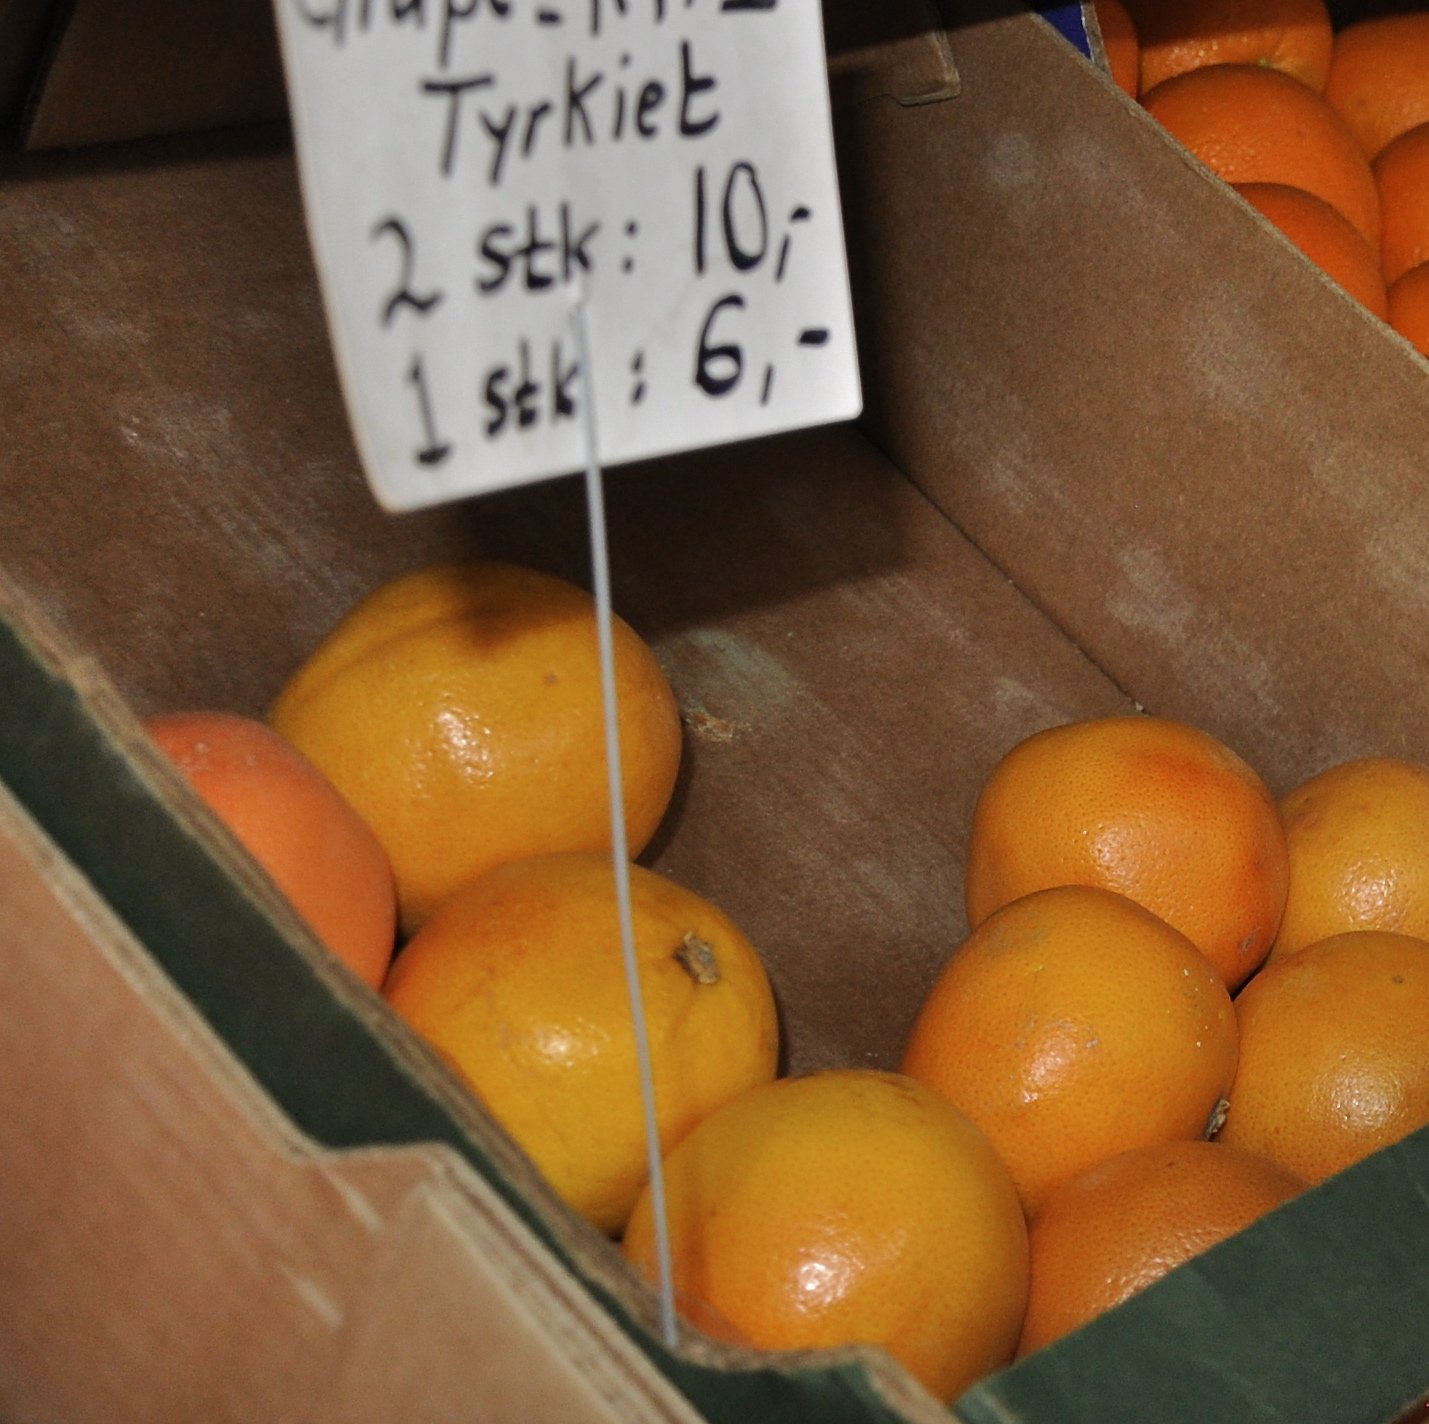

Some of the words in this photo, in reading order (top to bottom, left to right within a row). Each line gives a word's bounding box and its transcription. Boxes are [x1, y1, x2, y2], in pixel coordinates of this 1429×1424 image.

[419, 38, 720, 187] Tyrkiet
[370, 215, 444, 333] 2
[411, 351, 453, 465] 1
